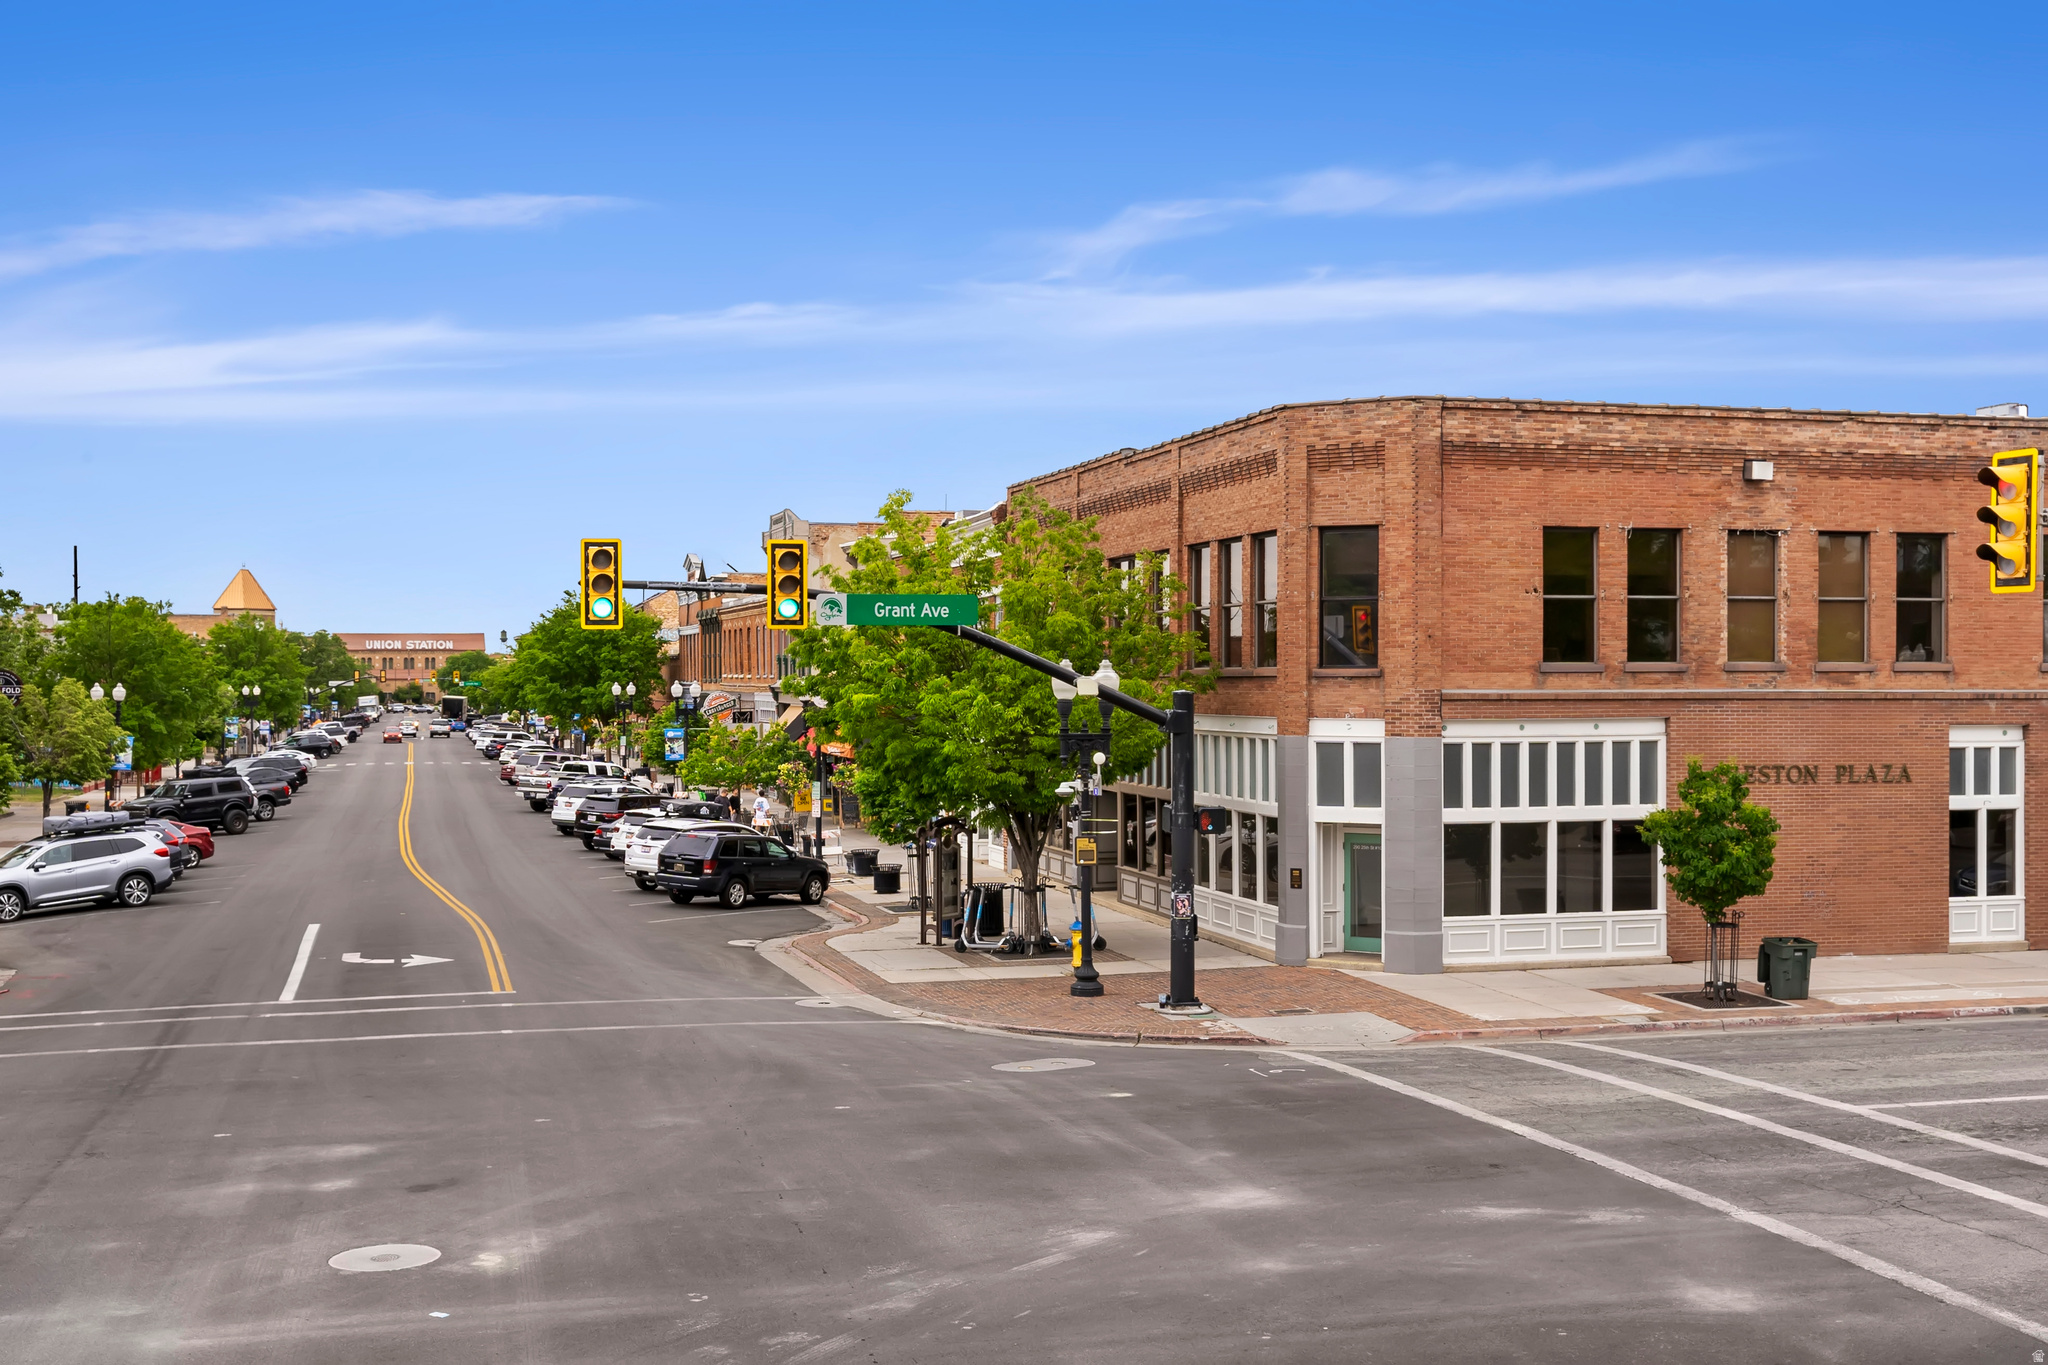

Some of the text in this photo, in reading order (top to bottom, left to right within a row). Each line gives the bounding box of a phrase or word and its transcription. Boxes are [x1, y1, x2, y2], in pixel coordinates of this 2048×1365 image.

[874, 602, 950, 618] Grant Ave
[365, 640, 453, 649] UNION STATION
[1835, 763, 1913, 784] PLAZA
